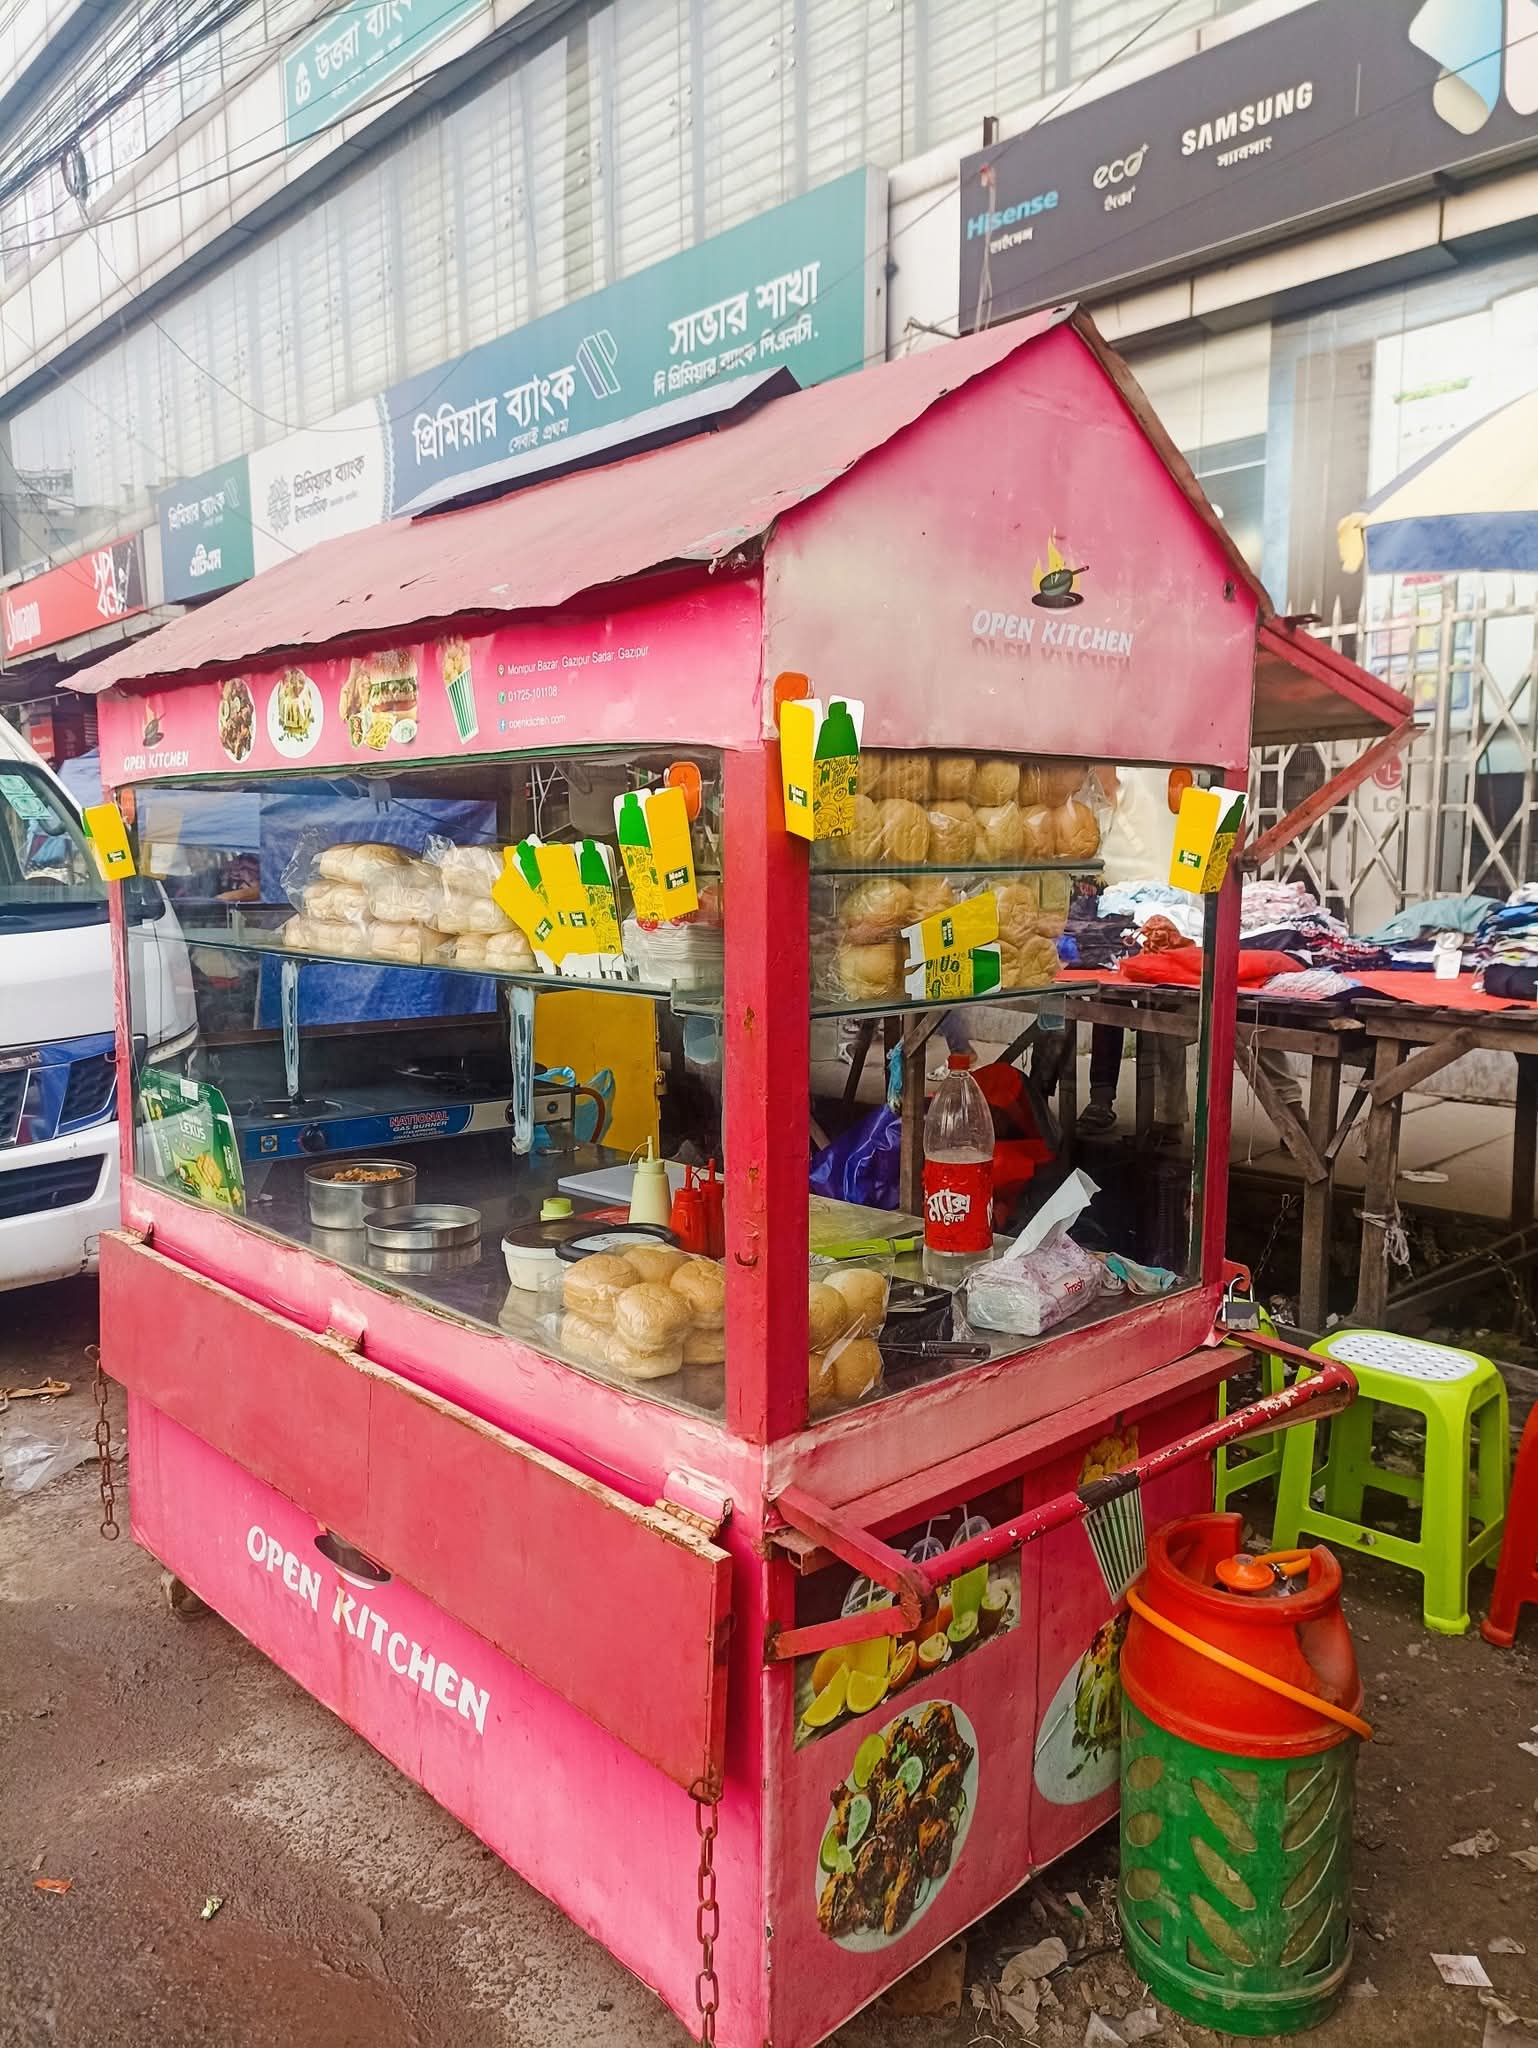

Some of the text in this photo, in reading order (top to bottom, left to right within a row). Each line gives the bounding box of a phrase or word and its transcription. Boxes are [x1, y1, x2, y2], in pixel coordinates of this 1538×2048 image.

[1181, 81, 1313, 156] SAMSUNG
[967, 190, 1060, 240] Hisense
[667, 261, 821, 355] সাভার শাখা
[653, 370, 666, 397] দি
[668, 359, 718, 393] প্রিমিয়ার
[718, 342, 757, 371] ব্যাংক
[412, 364, 577, 466] প্রিমিয়ার ব্যাংক
[508, 425, 540, 454] সেবাই
[293, 468, 333, 500] প্রিমিয়ার
[333, 454, 366, 483] ব্যাংক
[971, 608, 1134, 657] OPEN KITCHEN
[561, 654, 590, 669] Gazipur
[617, 645, 650, 660] Gazipur
[123, 751, 190, 772] OPEN KITCHEN
[180, 1120, 207, 1141] LEXUS
[389, 1110, 450, 1128] NATIONAL
[393, 1125, 411, 1133] GAS
[412, 1120, 448, 1130] BURNER
[246, 1525, 491, 1737] OPEN KITCHEN
